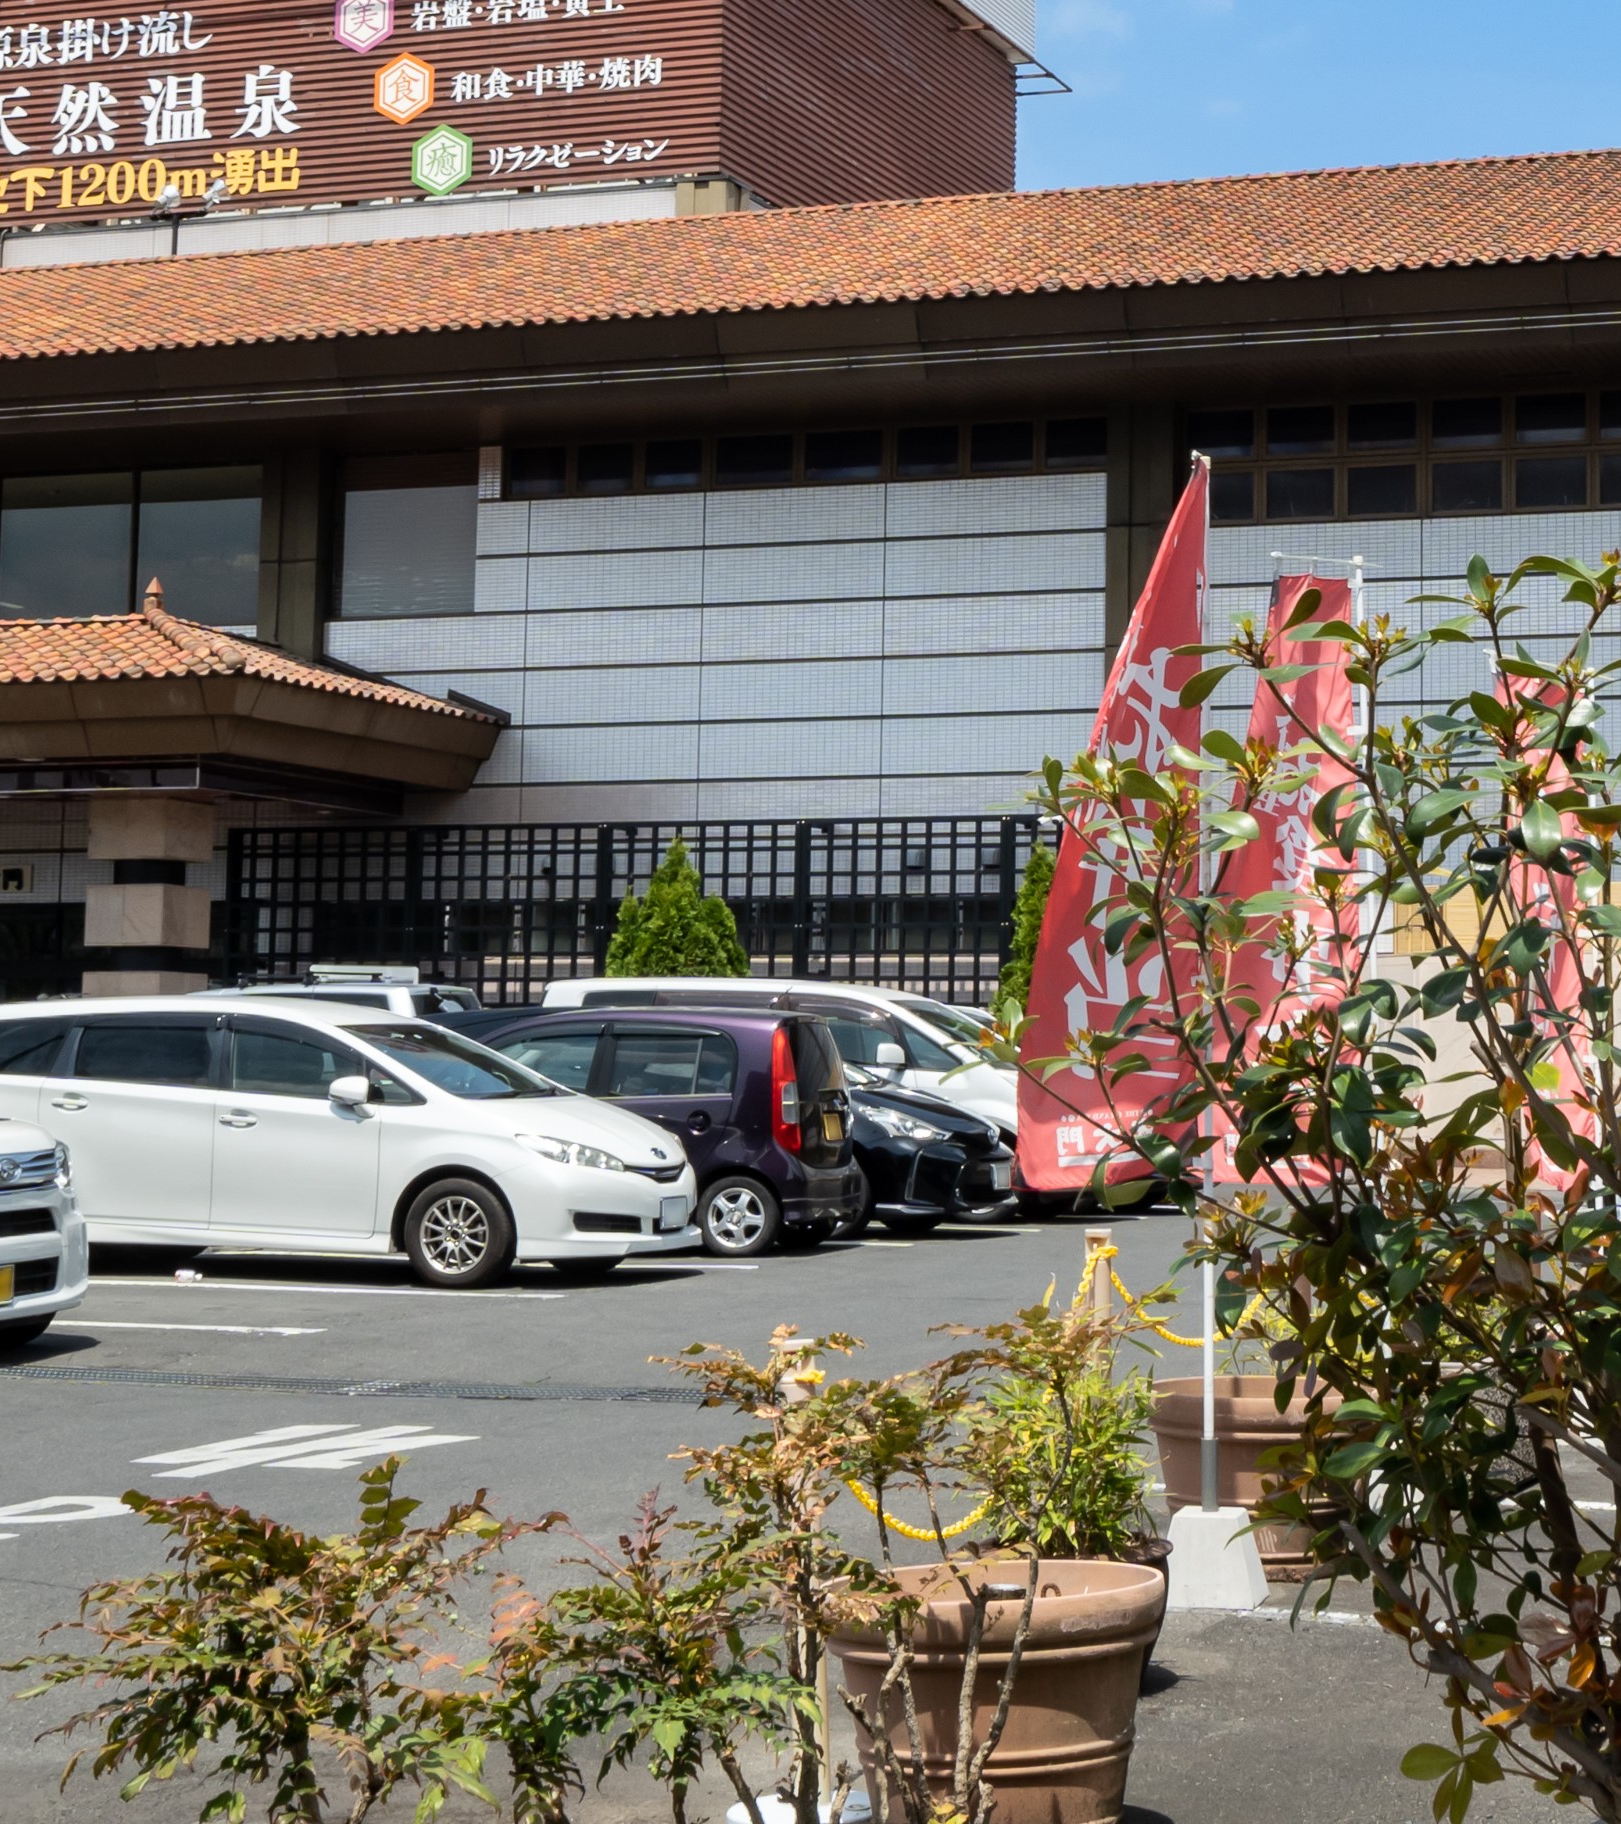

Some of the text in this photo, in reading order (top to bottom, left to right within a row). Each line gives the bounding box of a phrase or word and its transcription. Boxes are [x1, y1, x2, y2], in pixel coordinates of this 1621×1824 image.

[387, 69, 421, 105] 食
[450, 54, 663, 103] 和食・中華・焼肉
[488, 138, 670, 176] リラクゼーション
